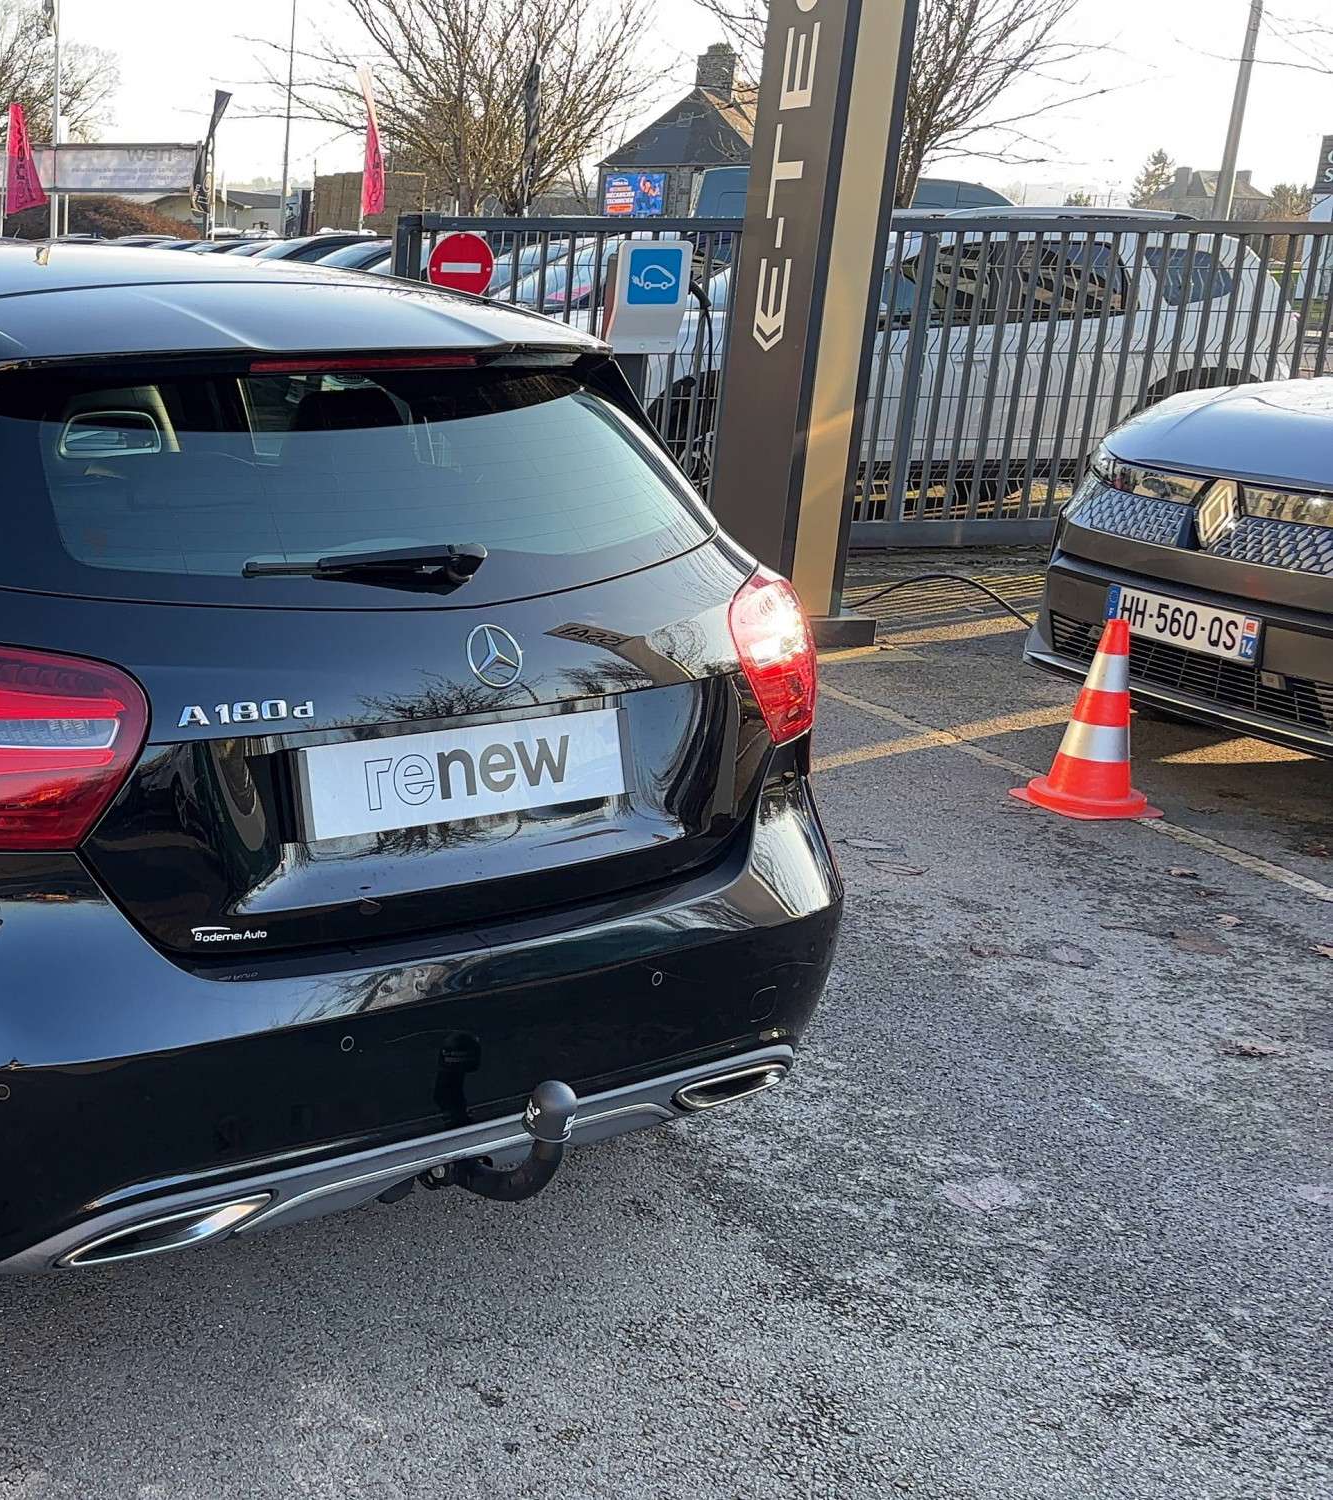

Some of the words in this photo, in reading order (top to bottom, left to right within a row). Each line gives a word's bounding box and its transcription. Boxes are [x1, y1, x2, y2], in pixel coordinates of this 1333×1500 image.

[752, 0, 821, 352] E-TE
[1241, 639, 1254, 656] 14
[364, 734, 569, 811] renew
[243, 930, 267, 940] Auto
